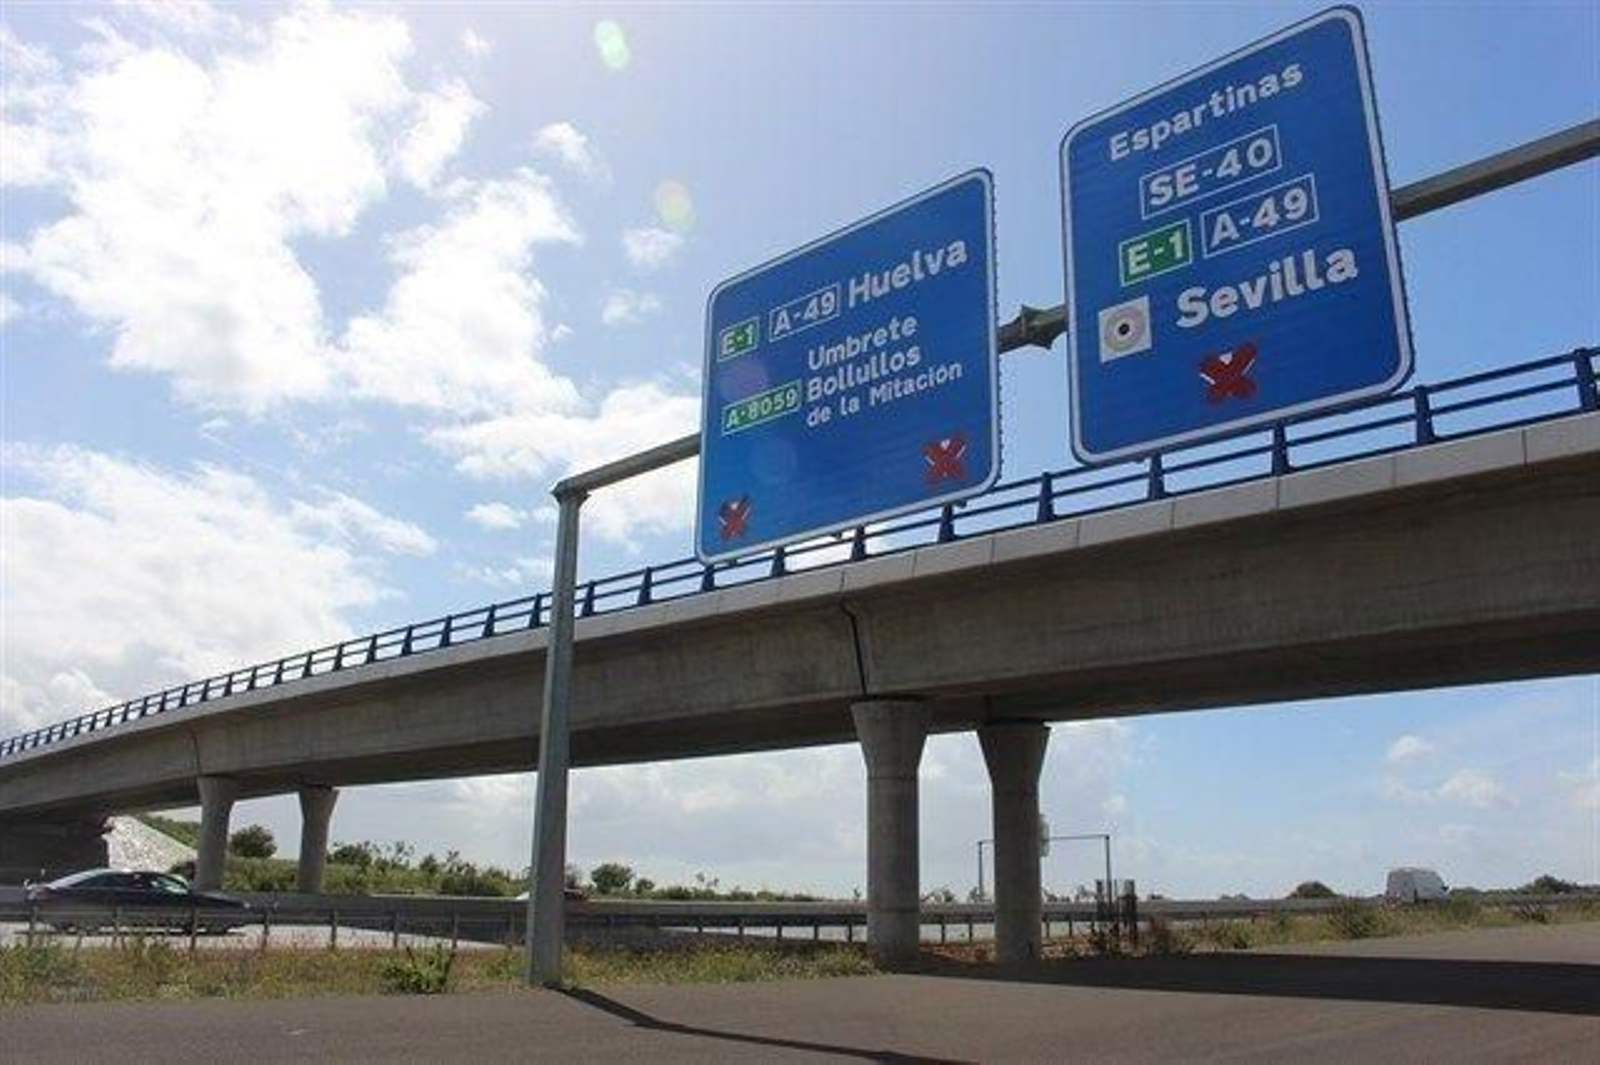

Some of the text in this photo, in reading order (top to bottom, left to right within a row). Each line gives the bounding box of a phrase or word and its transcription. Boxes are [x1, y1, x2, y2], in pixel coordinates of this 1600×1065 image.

[1109, 62, 1303, 162] Espartinas
[1149, 136, 1273, 207] SE-40
[1126, 188, 1307, 276] E-1 A-49
[720, 239, 968, 355] E-1 A-49 Huelva
[1176, 247, 1358, 329] Sevilla
[808, 315, 918, 371] Umbrete
[726, 345, 921, 429] A-8059 Bollullos
[807, 403, 830, 427] de
[840, 392, 860, 415] la
